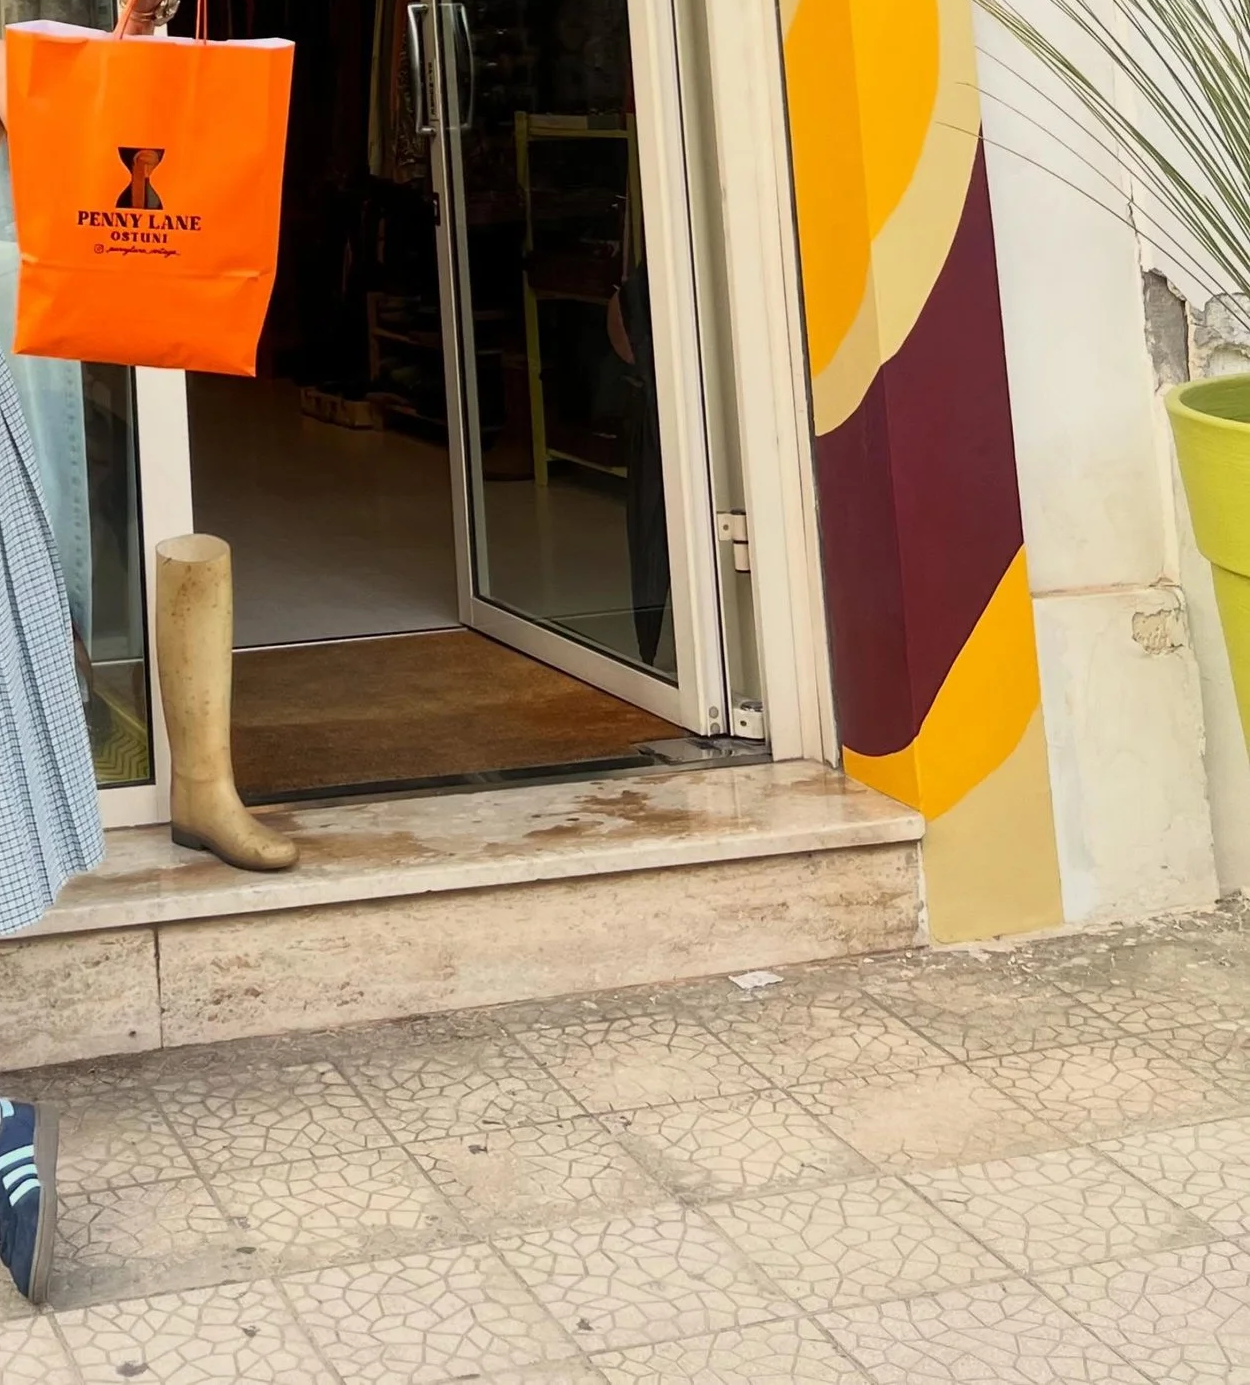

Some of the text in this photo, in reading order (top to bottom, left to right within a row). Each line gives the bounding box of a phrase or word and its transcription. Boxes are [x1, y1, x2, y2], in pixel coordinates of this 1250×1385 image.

[77, 210, 202, 231] PENNY LANE
[110, 231, 168, 244] OSTUNI
